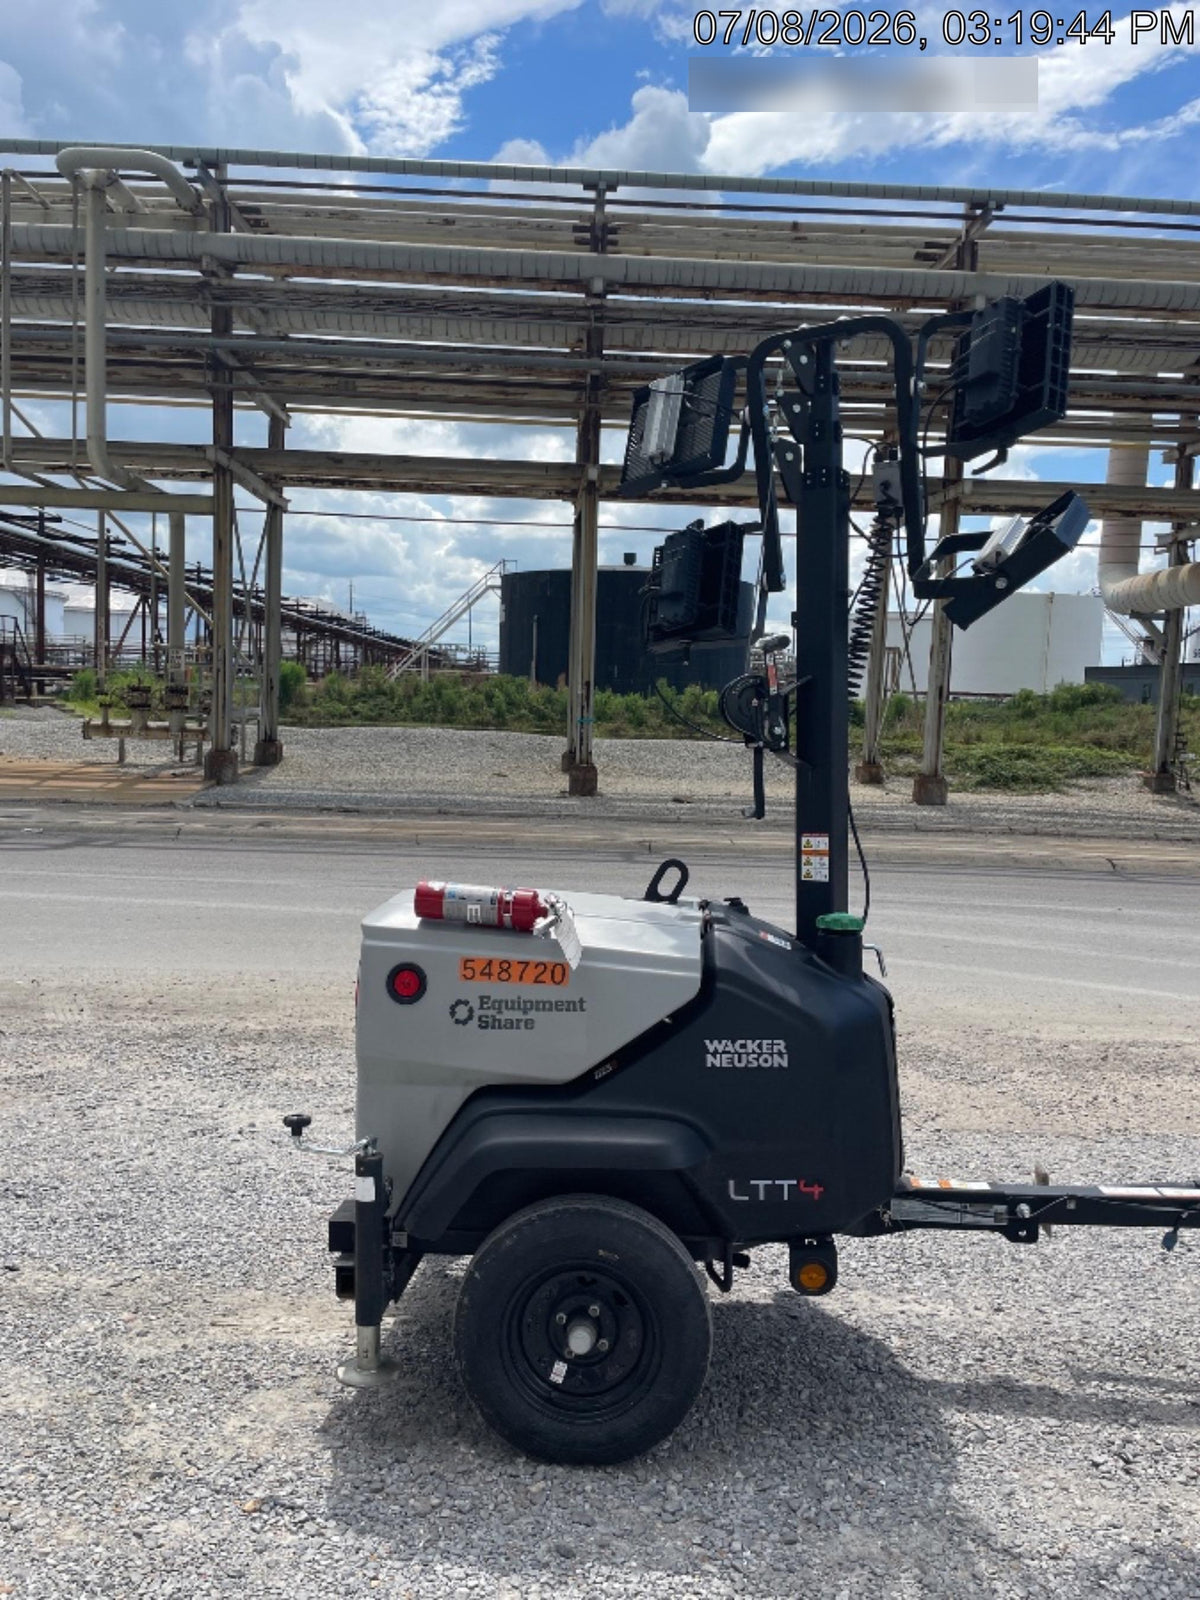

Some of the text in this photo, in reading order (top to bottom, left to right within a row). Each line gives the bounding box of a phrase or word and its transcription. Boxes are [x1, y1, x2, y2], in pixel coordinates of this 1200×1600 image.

[462, 959, 566, 985] 548720
[477, 995, 586, 1015] Equipment
[477, 1014, 535, 1030] Share
[704, 1039, 788, 1053] WACKER
[706, 1053, 789, 1068] NEUSON
[728, 1179, 824, 1201] LTT4
